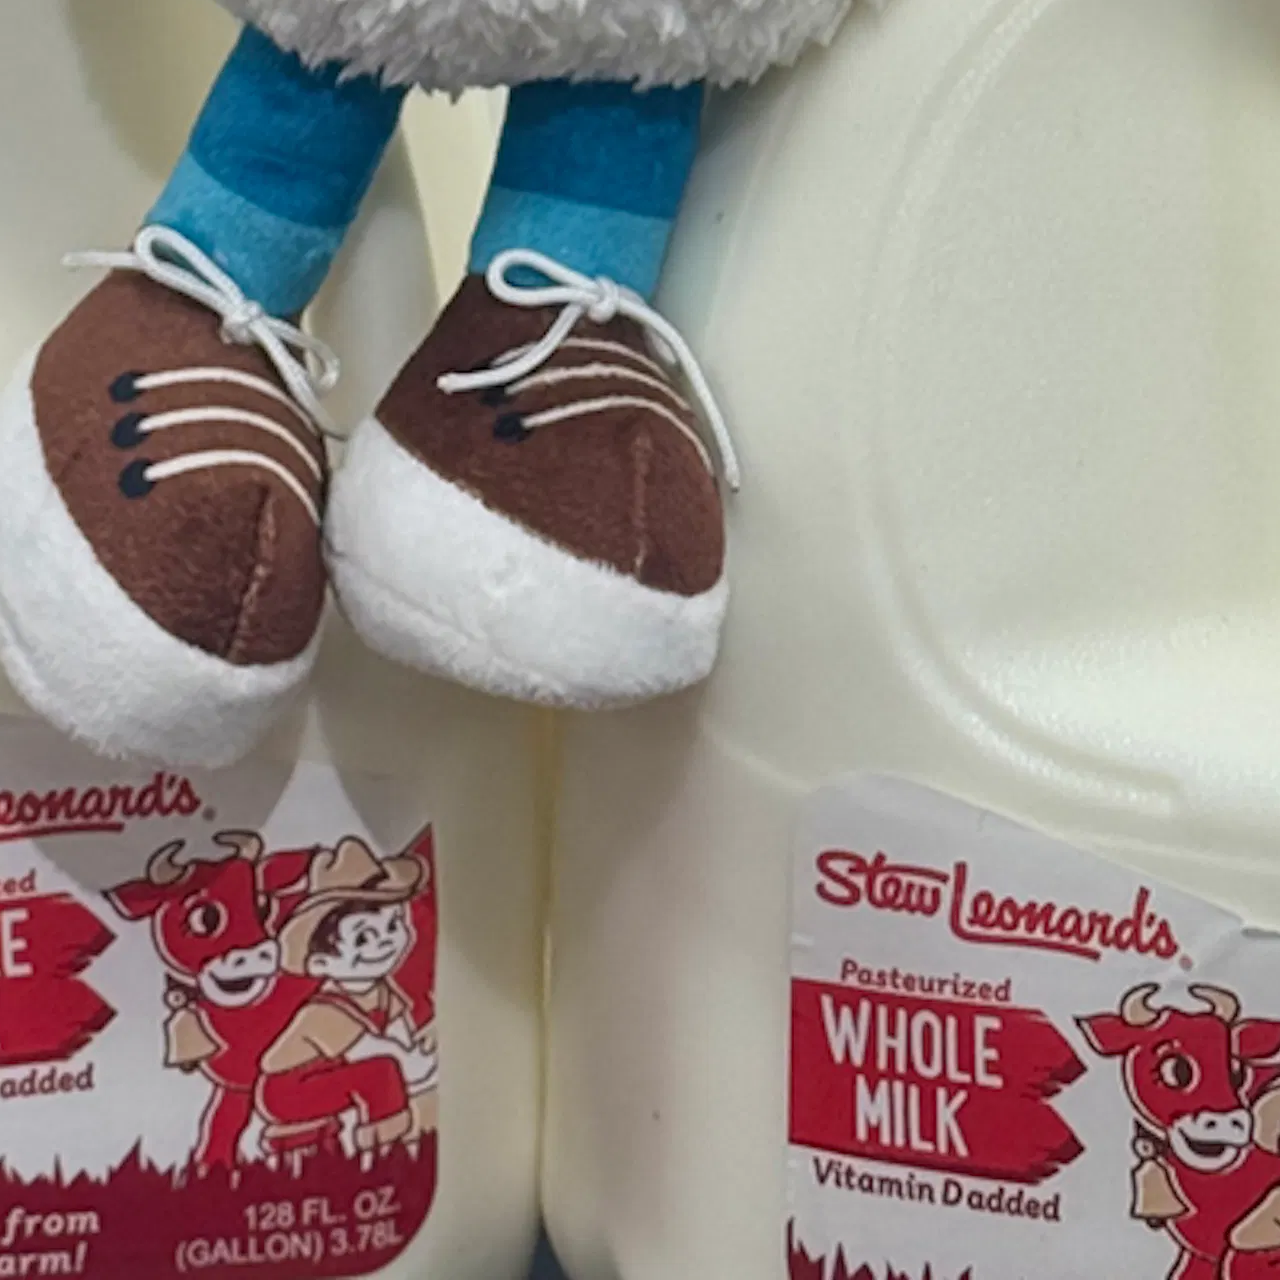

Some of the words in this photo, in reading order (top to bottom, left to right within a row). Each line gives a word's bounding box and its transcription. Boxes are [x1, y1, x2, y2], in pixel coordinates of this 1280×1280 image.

[815, 849, 951, 918] Stew
[948, 861, 1180, 963] Leonard's
[839, 957, 1013, 1003] Pasteurized
[820, 991, 1004, 1087] WHOLE
[853, 1073, 970, 1159] MILK
[244, 1201, 296, 1231] 128
[812, 1156, 937, 1207] Vitamin
[967, 1187, 1063, 1222] added
[0, 1206, 101, 1246] from
[175, 1231, 325, 1273] (GALLON)
[330, 1218, 403, 1257] 3.78L
